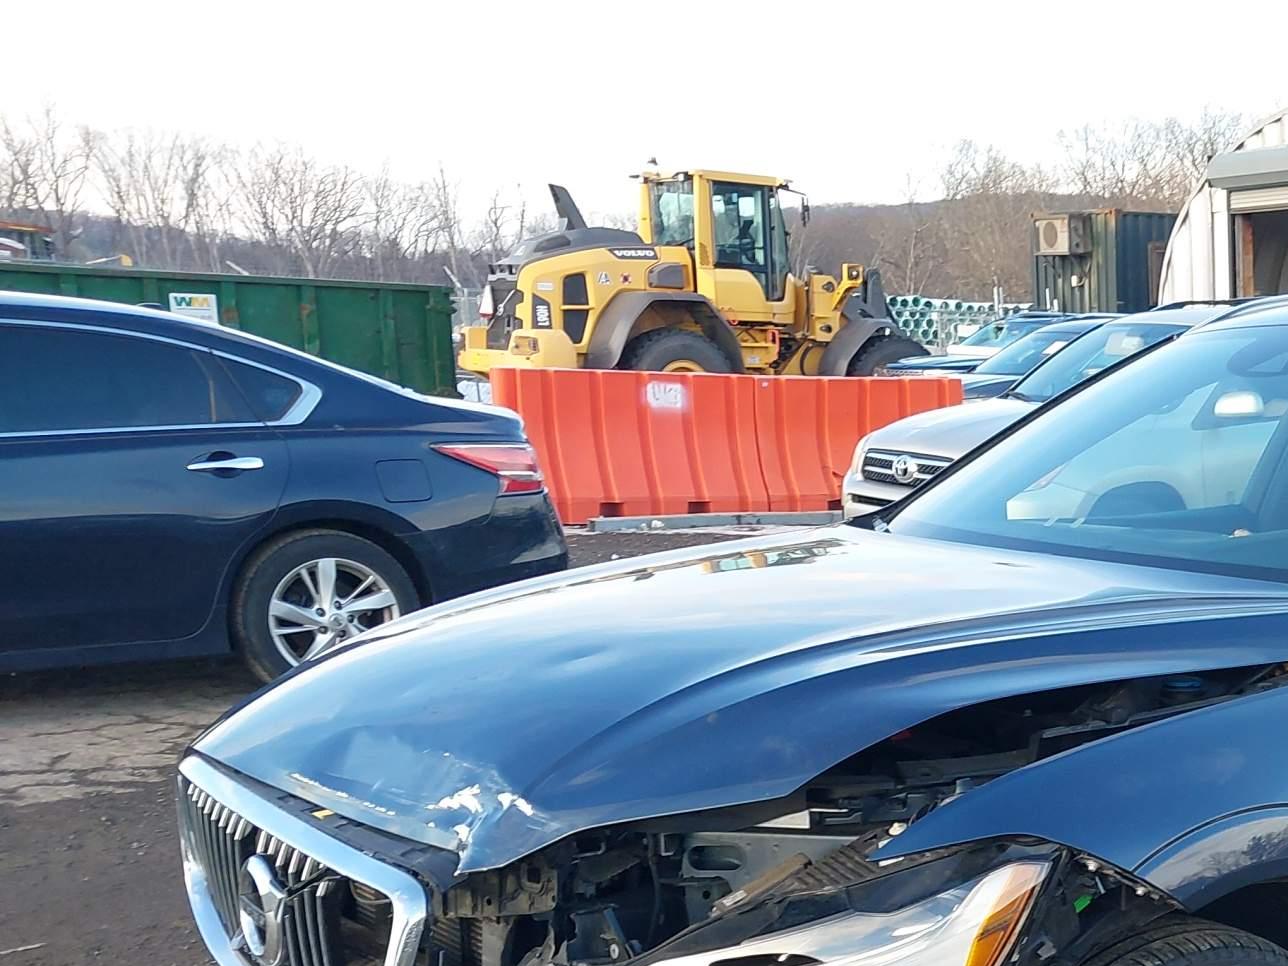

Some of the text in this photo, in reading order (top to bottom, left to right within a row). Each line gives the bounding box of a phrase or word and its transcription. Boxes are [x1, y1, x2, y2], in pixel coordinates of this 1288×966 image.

[613, 249, 655, 257] VOLVO
[173, 296, 210, 307] WM
[535, 304, 550, 327] L90H
